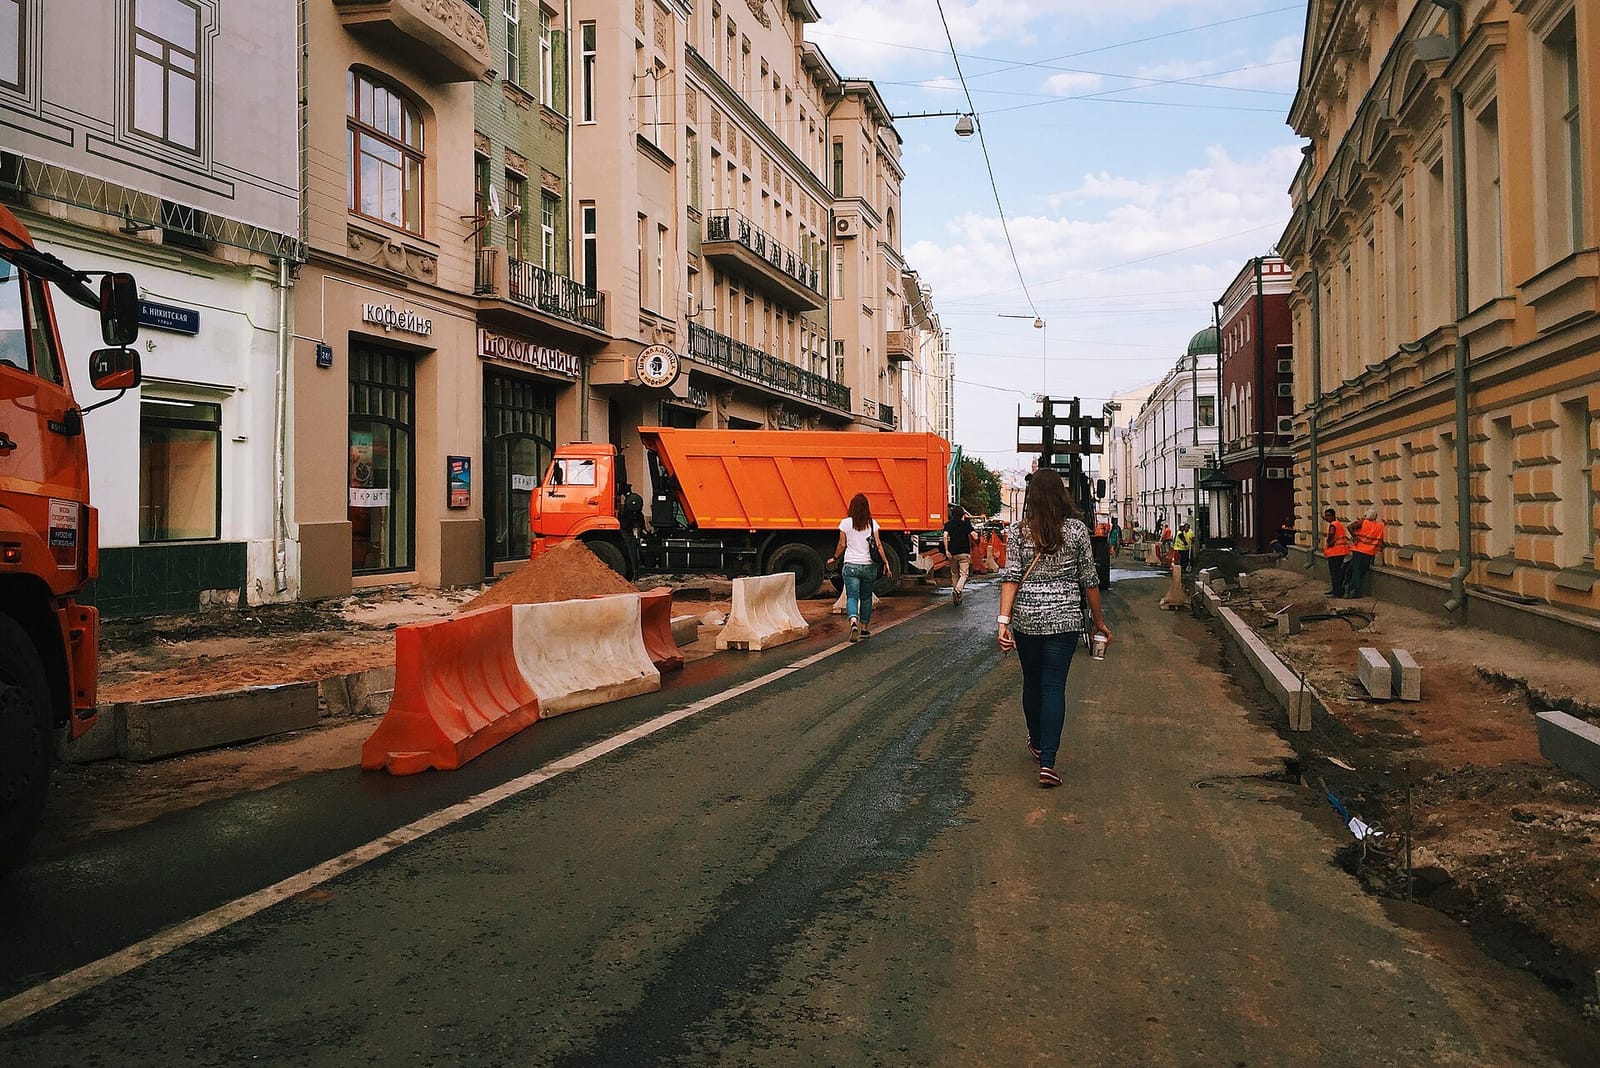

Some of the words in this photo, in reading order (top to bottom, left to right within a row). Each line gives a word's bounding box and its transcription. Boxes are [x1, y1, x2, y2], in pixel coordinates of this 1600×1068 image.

[150, 307, 188, 322] НИКИТСКАЯ
[363, 304, 432, 335] кофейня
[478, 328, 581, 376] ШОКОЛАДНИЦА
